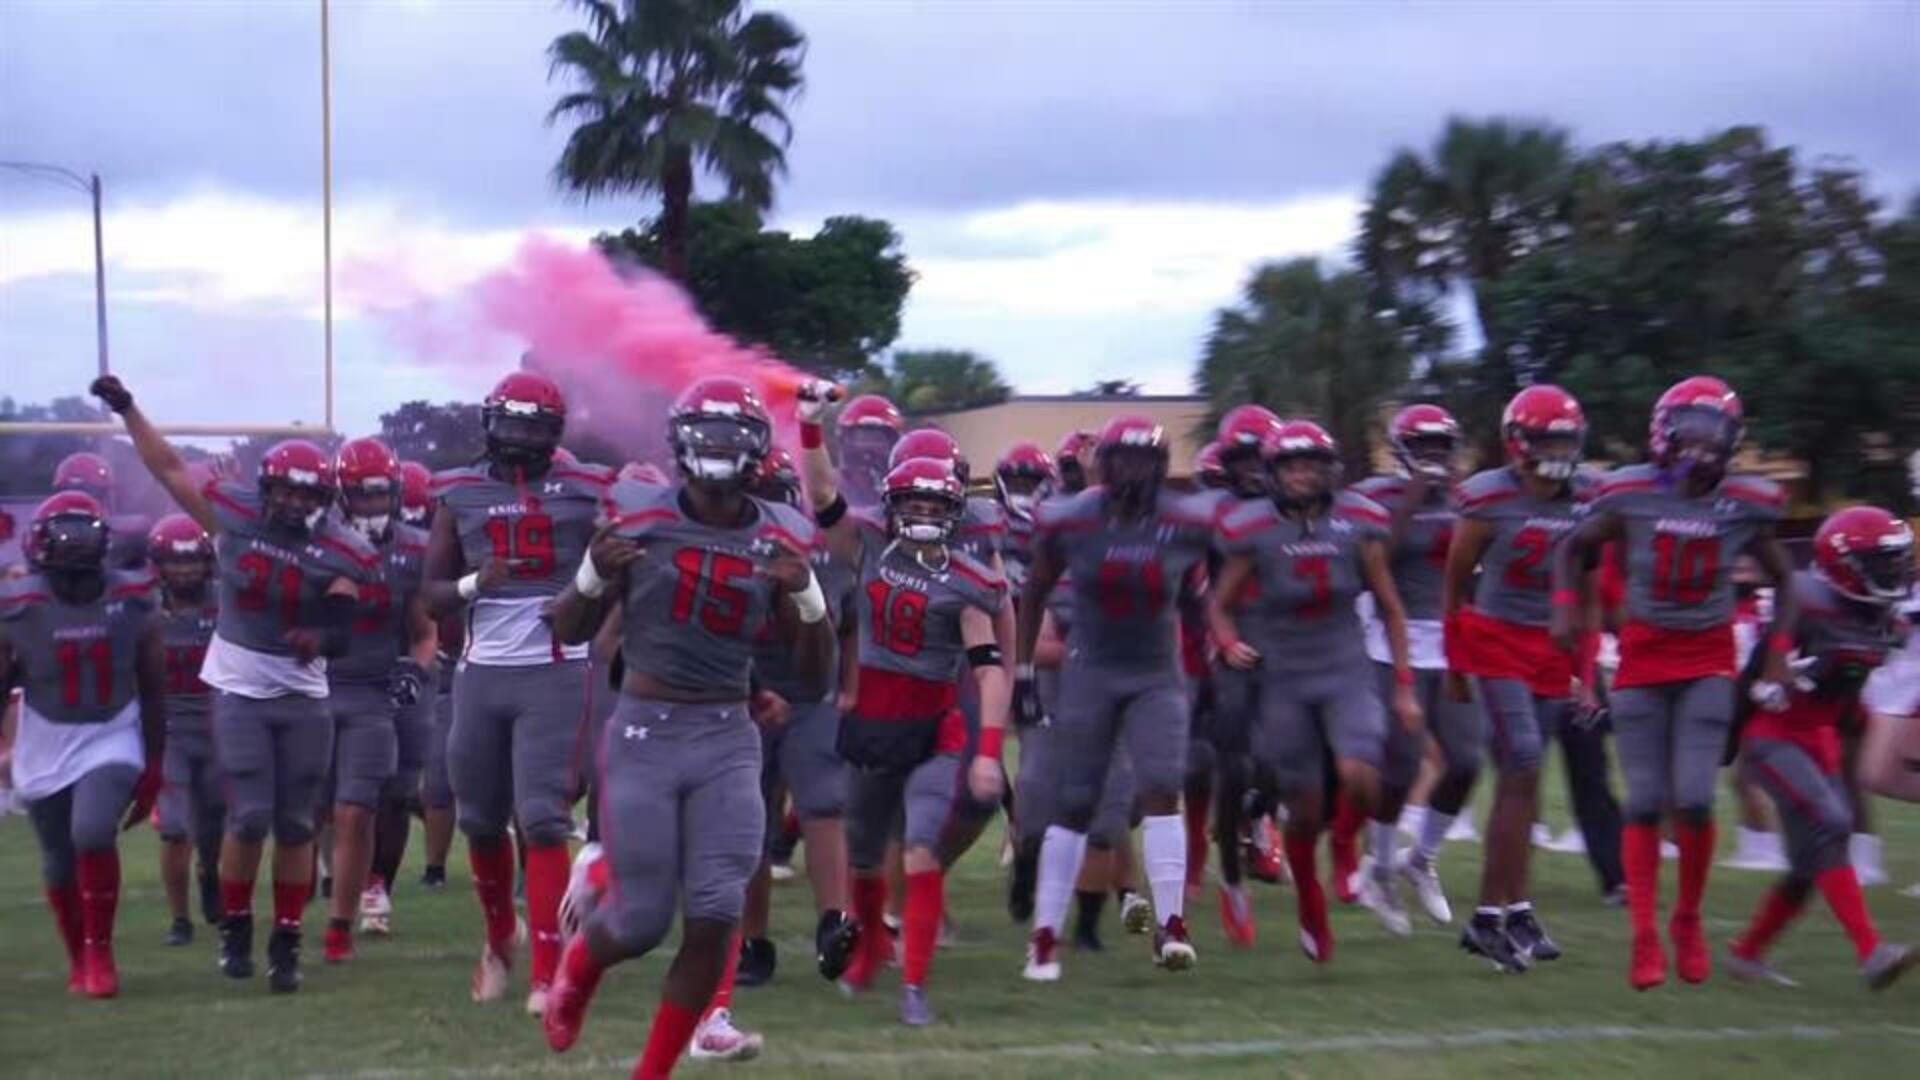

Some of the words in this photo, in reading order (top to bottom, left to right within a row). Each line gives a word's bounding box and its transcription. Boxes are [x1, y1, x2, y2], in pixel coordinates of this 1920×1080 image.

[484, 514, 556, 578] 19
[1653, 533, 1723, 603] 10
[673, 547, 753, 636] 15
[867, 579, 929, 657] 18
[56, 639, 113, 706] 11
